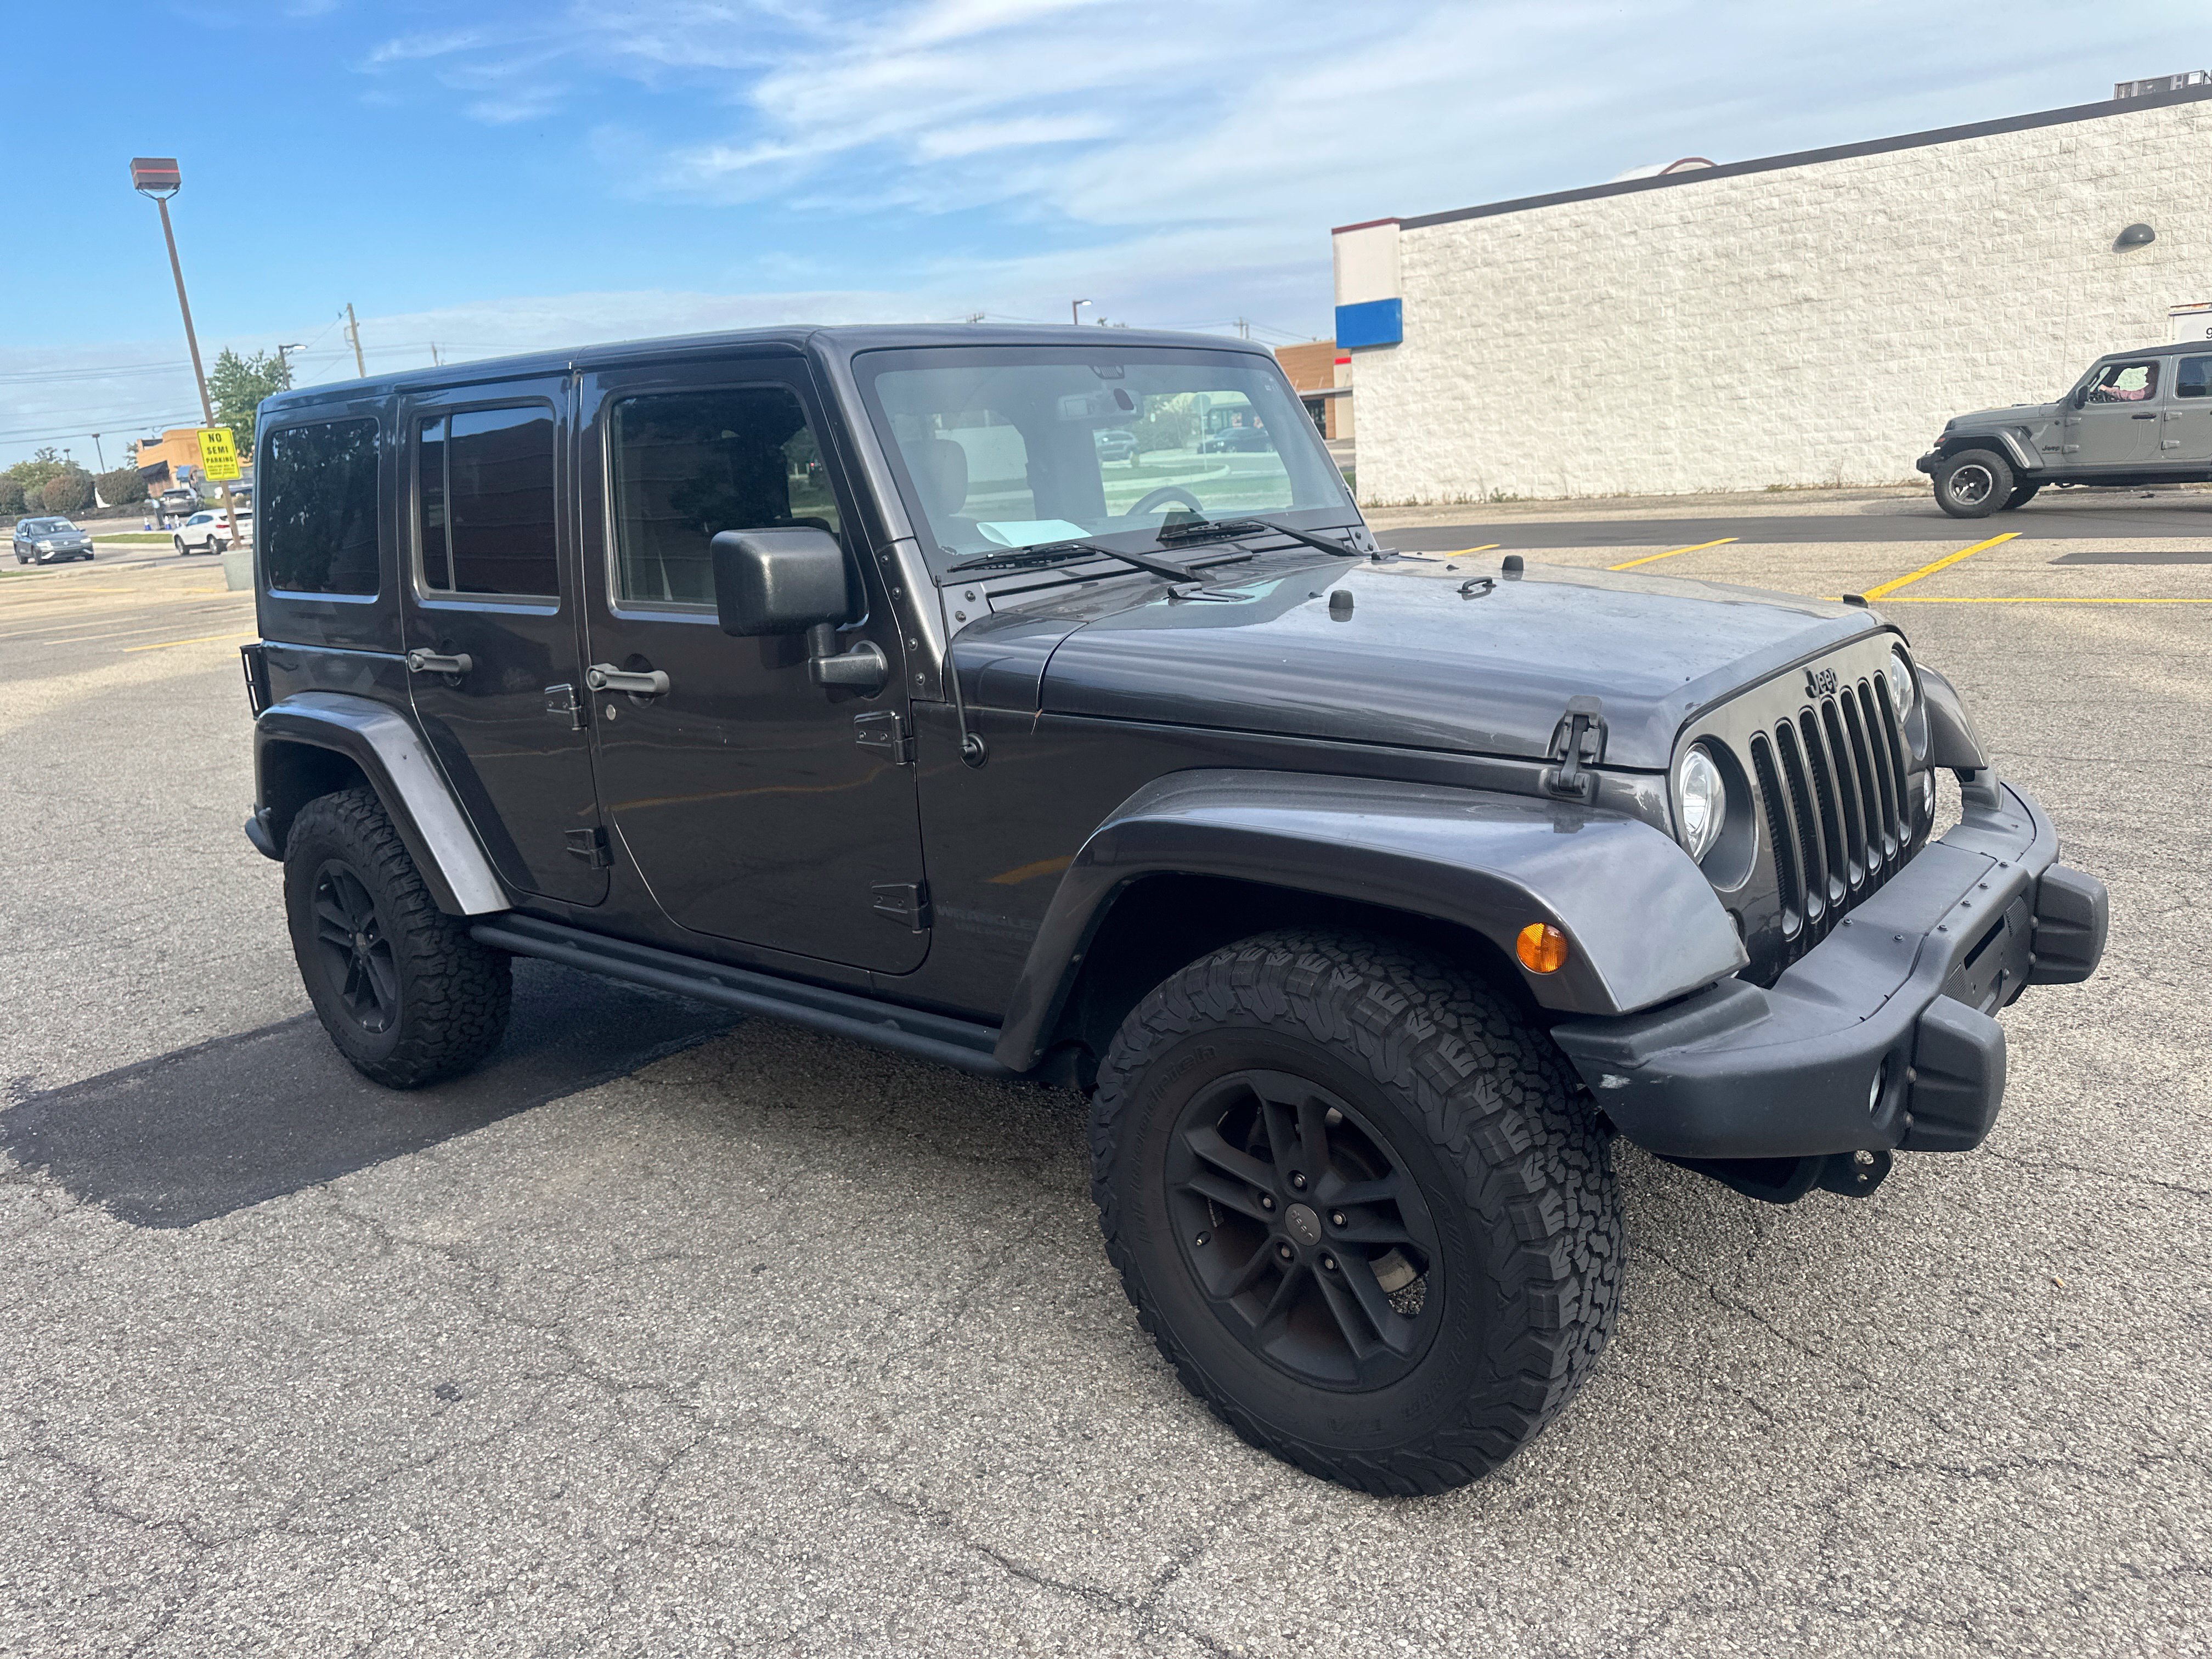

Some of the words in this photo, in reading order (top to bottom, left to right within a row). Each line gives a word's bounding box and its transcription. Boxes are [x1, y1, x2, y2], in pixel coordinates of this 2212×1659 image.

[208, 433, 222, 443] NO
[207, 445, 228, 455] SEMI
[206, 455, 233, 464] PARKING
[1805, 668, 1838, 698] Jeep
[1290, 1209, 1314, 1240] Jeep
